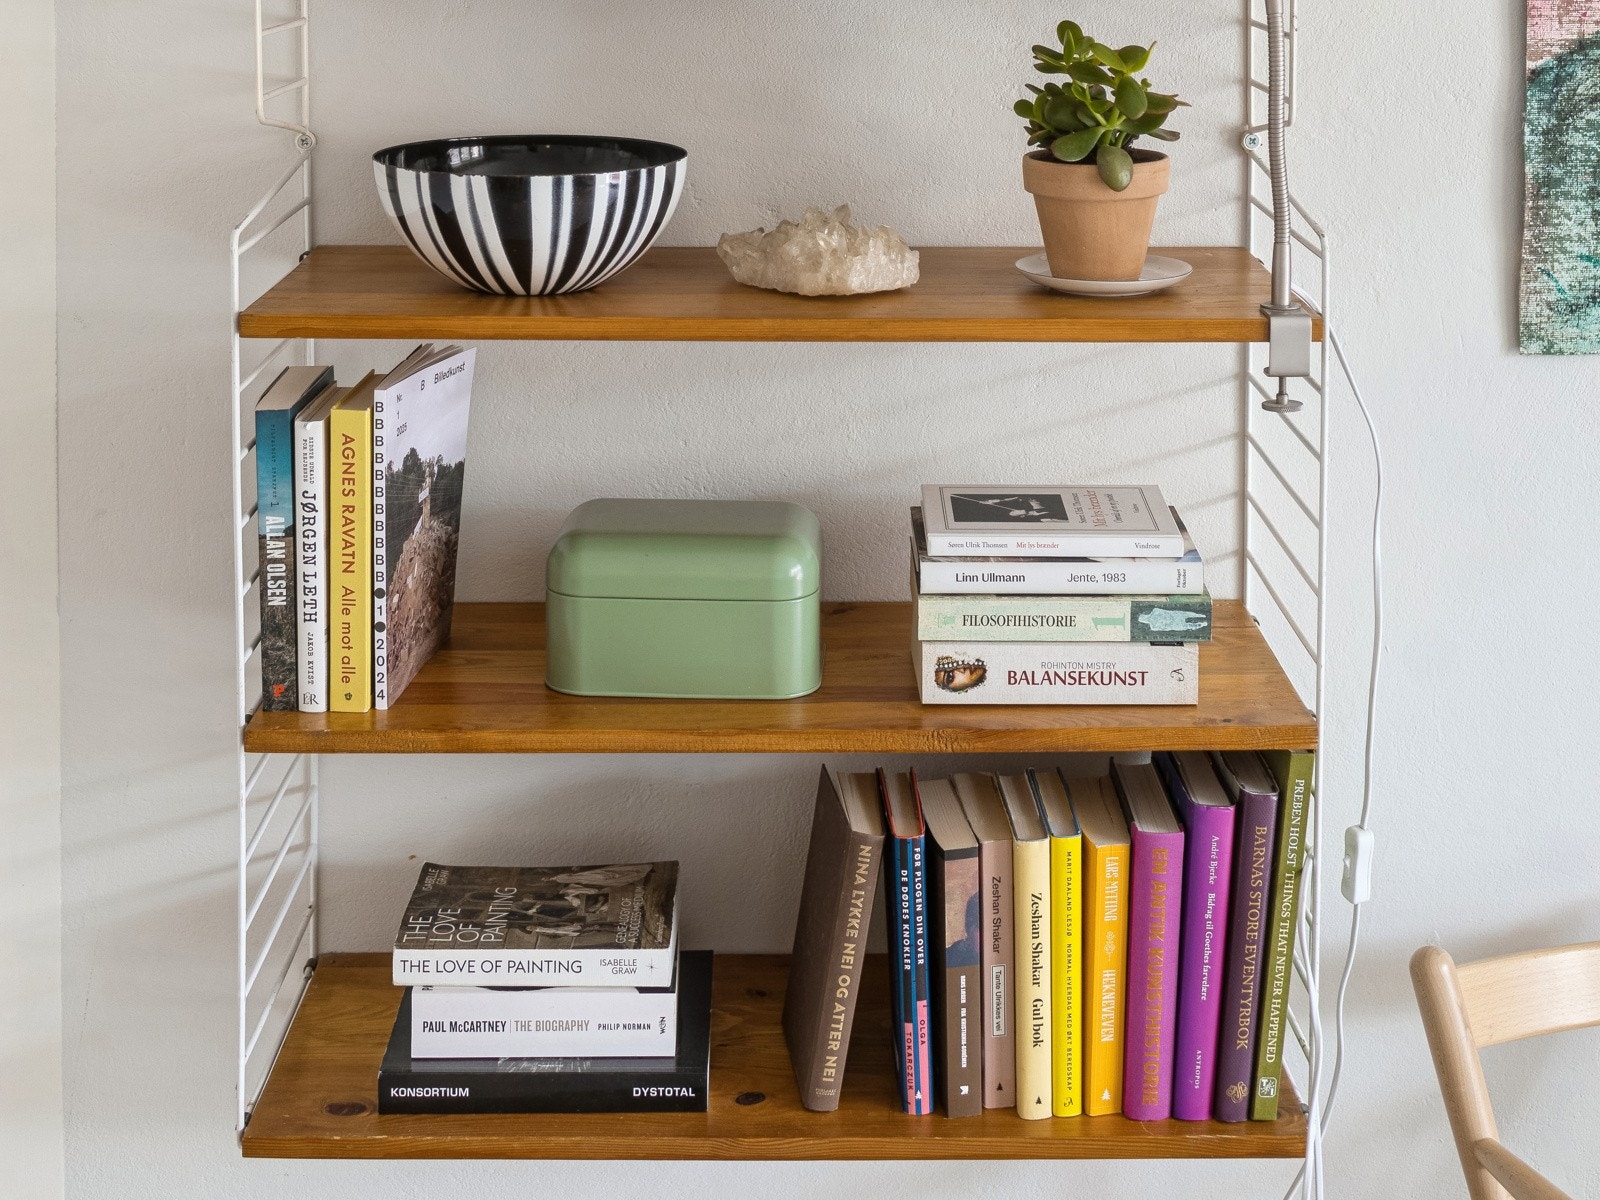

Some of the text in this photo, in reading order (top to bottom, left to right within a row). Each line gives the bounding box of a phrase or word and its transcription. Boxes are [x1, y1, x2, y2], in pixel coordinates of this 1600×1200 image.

[266, 516, 287, 606] ALLAN OLSEN
[300, 490, 318, 623] JØRGEN LETH
[342, 433, 356, 684] AGNES RAVATN Alle mot alle
[956, 573, 1126, 583] Linn Ullmann Jente, 1983
[962, 614, 1076, 627] FILOSOFIHISTORIE
[1008, 670, 1148, 686] BALANSEKUNST
[1041, 662, 1116, 670] ROHINTON MISTRY
[1291, 779, 1304, 824] PREBEN
[1212, 835, 1220, 858] André
[1287, 828, 1300, 867] HOLST
[854, 844, 872, 885] NINA
[901, 870, 908, 882] DE
[1106, 856, 1119, 878] LARS
[1209, 861, 1218, 884] Bjerke
[914, 871, 922, 912] PLOGEN
[1104, 882, 1118, 922] MYTTING
[1205, 893, 1216, 919] Bidrag
[1281, 871, 1294, 918] THINGS
[402, 916, 432, 942] THE
[430, 908, 462, 942] LOVE
[480, 888, 517, 942] PAINTING
[616, 896, 632, 944] GENEALOGY OF
[629, 912, 642, 937] SUCCESS
[846, 889, 865, 938] LYKKE
[992, 876, 1002, 954] Zeshan Shakar
[456, 923, 481, 942] OF
[902, 924, 911, 970] KNOKLER
[1204, 932, 1213, 964] Goethes
[1236, 826, 1267, 1050] BARNAS STORE EVENTYRBOK
[1278, 920, 1290, 954] THAT
[400, 960, 582, 974] THE LOVE OF PAINTING
[840, 942, 856, 970] NEI
[1031, 892, 1044, 1048] Zeshan Shakar Gul bok
[836, 974, 850, 999] OG
[1142, 848, 1168, 1106] EN ANTIK KUNSTHISTORIE
[1202, 965, 1212, 1001] farvelære
[1273, 956, 1286, 996] NEVER
[422, 1021, 446, 1032] PAUL
[450, 1020, 506, 1032] McCARTNEY
[514, 1020, 532, 1032] THE
[536, 1020, 590, 1032] BIOGRAPHY
[828, 1002, 846, 1051] ATTER
[1266, 999, 1282, 1063] HAPPENED
[822, 1056, 838, 1082] NEI
[390, 1088, 696, 1097] KONSORTIUM DYSTOTAL
